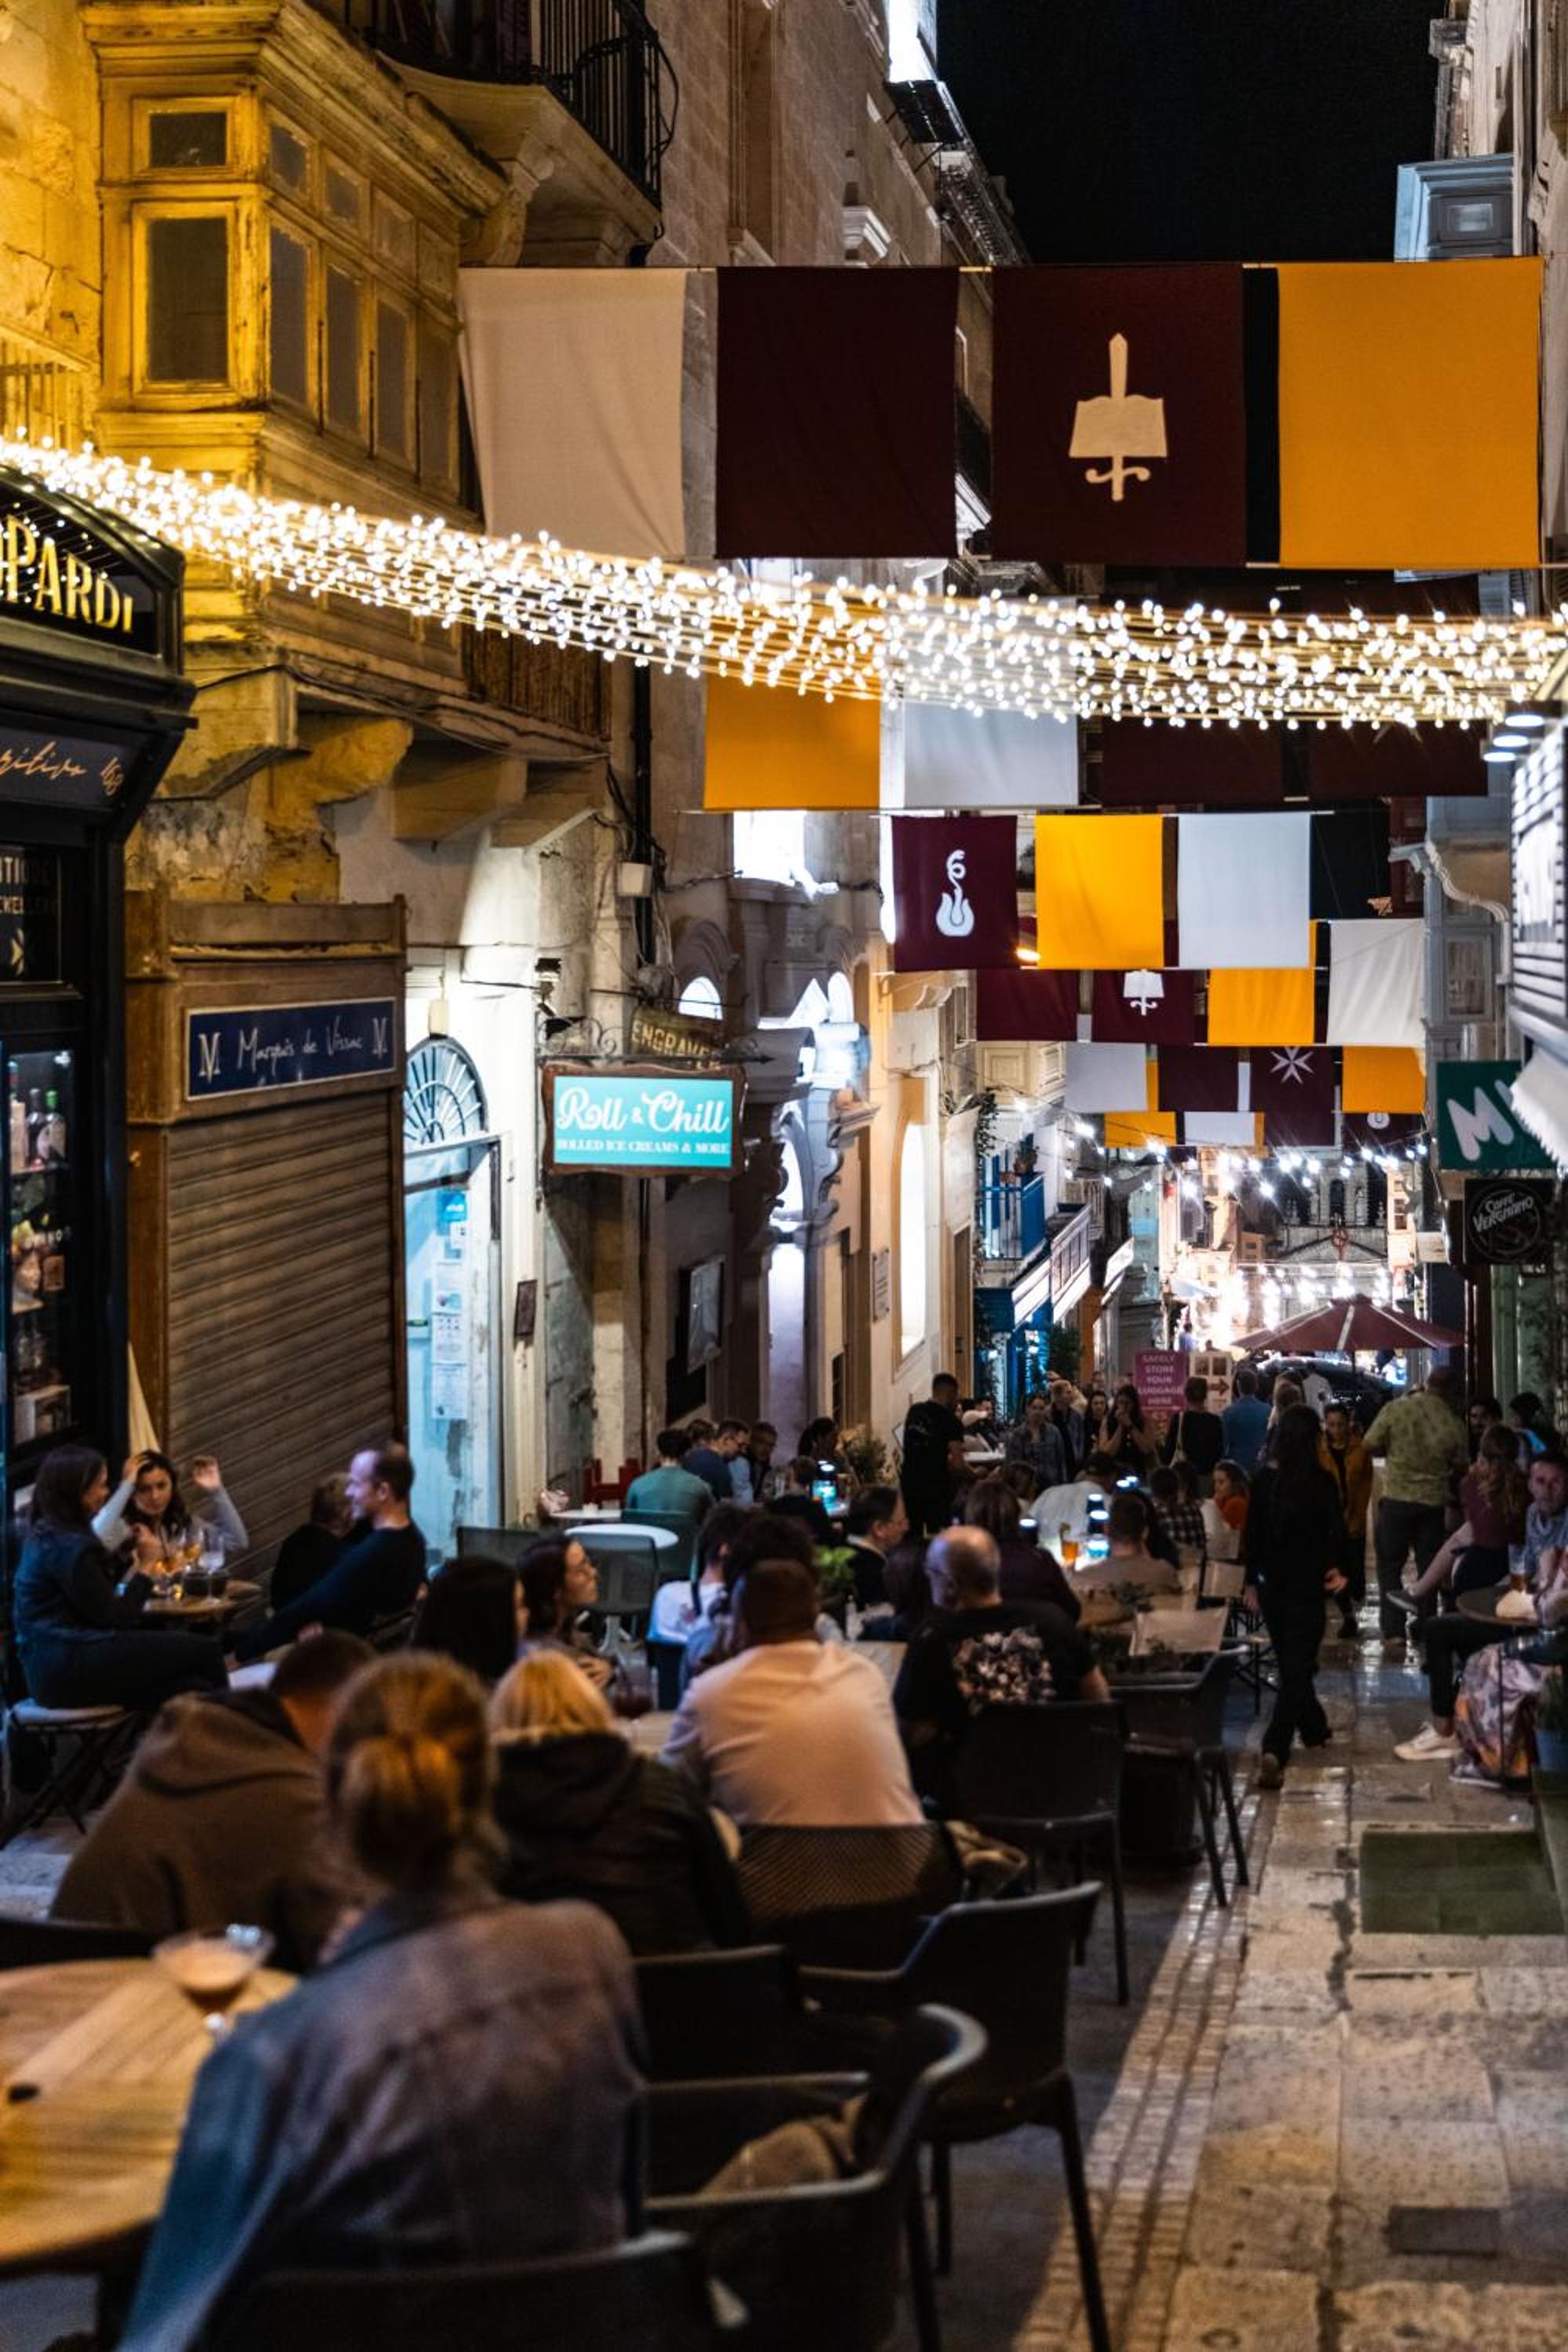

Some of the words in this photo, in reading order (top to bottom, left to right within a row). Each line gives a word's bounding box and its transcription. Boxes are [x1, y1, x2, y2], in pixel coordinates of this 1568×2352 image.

[0, 513, 133, 633] PARDI
[301, 1028, 318, 1054] de
[557, 1086, 627, 1131] Roll
[631, 1105, 644, 1124] &
[641, 1090, 730, 1134] Chill
[605, 1140, 626, 1152] ICE
[629, 1141, 679, 1152] CREAMS
[681, 1142, 691, 1153] &
[695, 1142, 729, 1154] MORE
[1145, 1365, 1174, 1374] STORE
[1138, 1386, 1184, 1395] LUGGAGE
